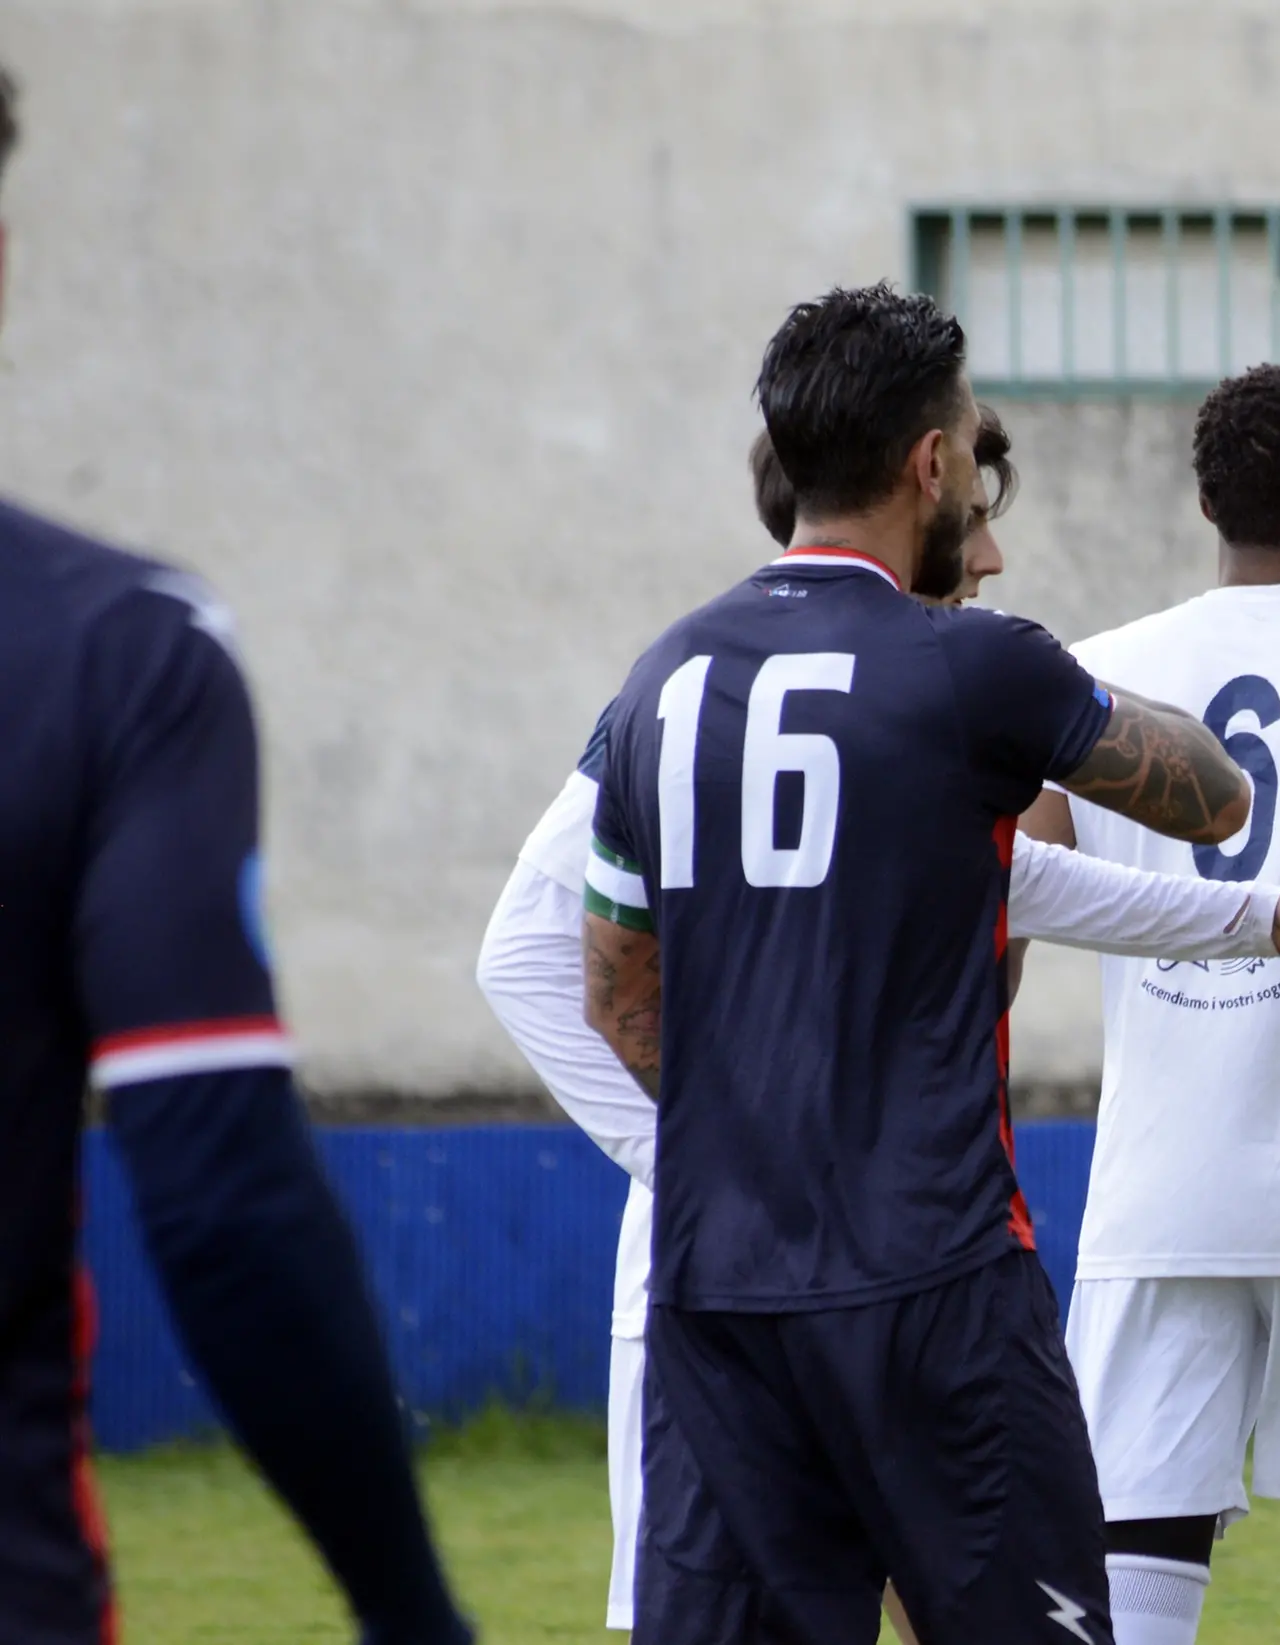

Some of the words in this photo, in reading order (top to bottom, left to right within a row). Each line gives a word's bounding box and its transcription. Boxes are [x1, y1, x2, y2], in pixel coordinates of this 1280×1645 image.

[657, 652, 856, 889] 16
[1141, 978, 1209, 1010] accendiamo
[1212, 996, 1217, 1010] i
[1218, 990, 1255, 1010] vostri
